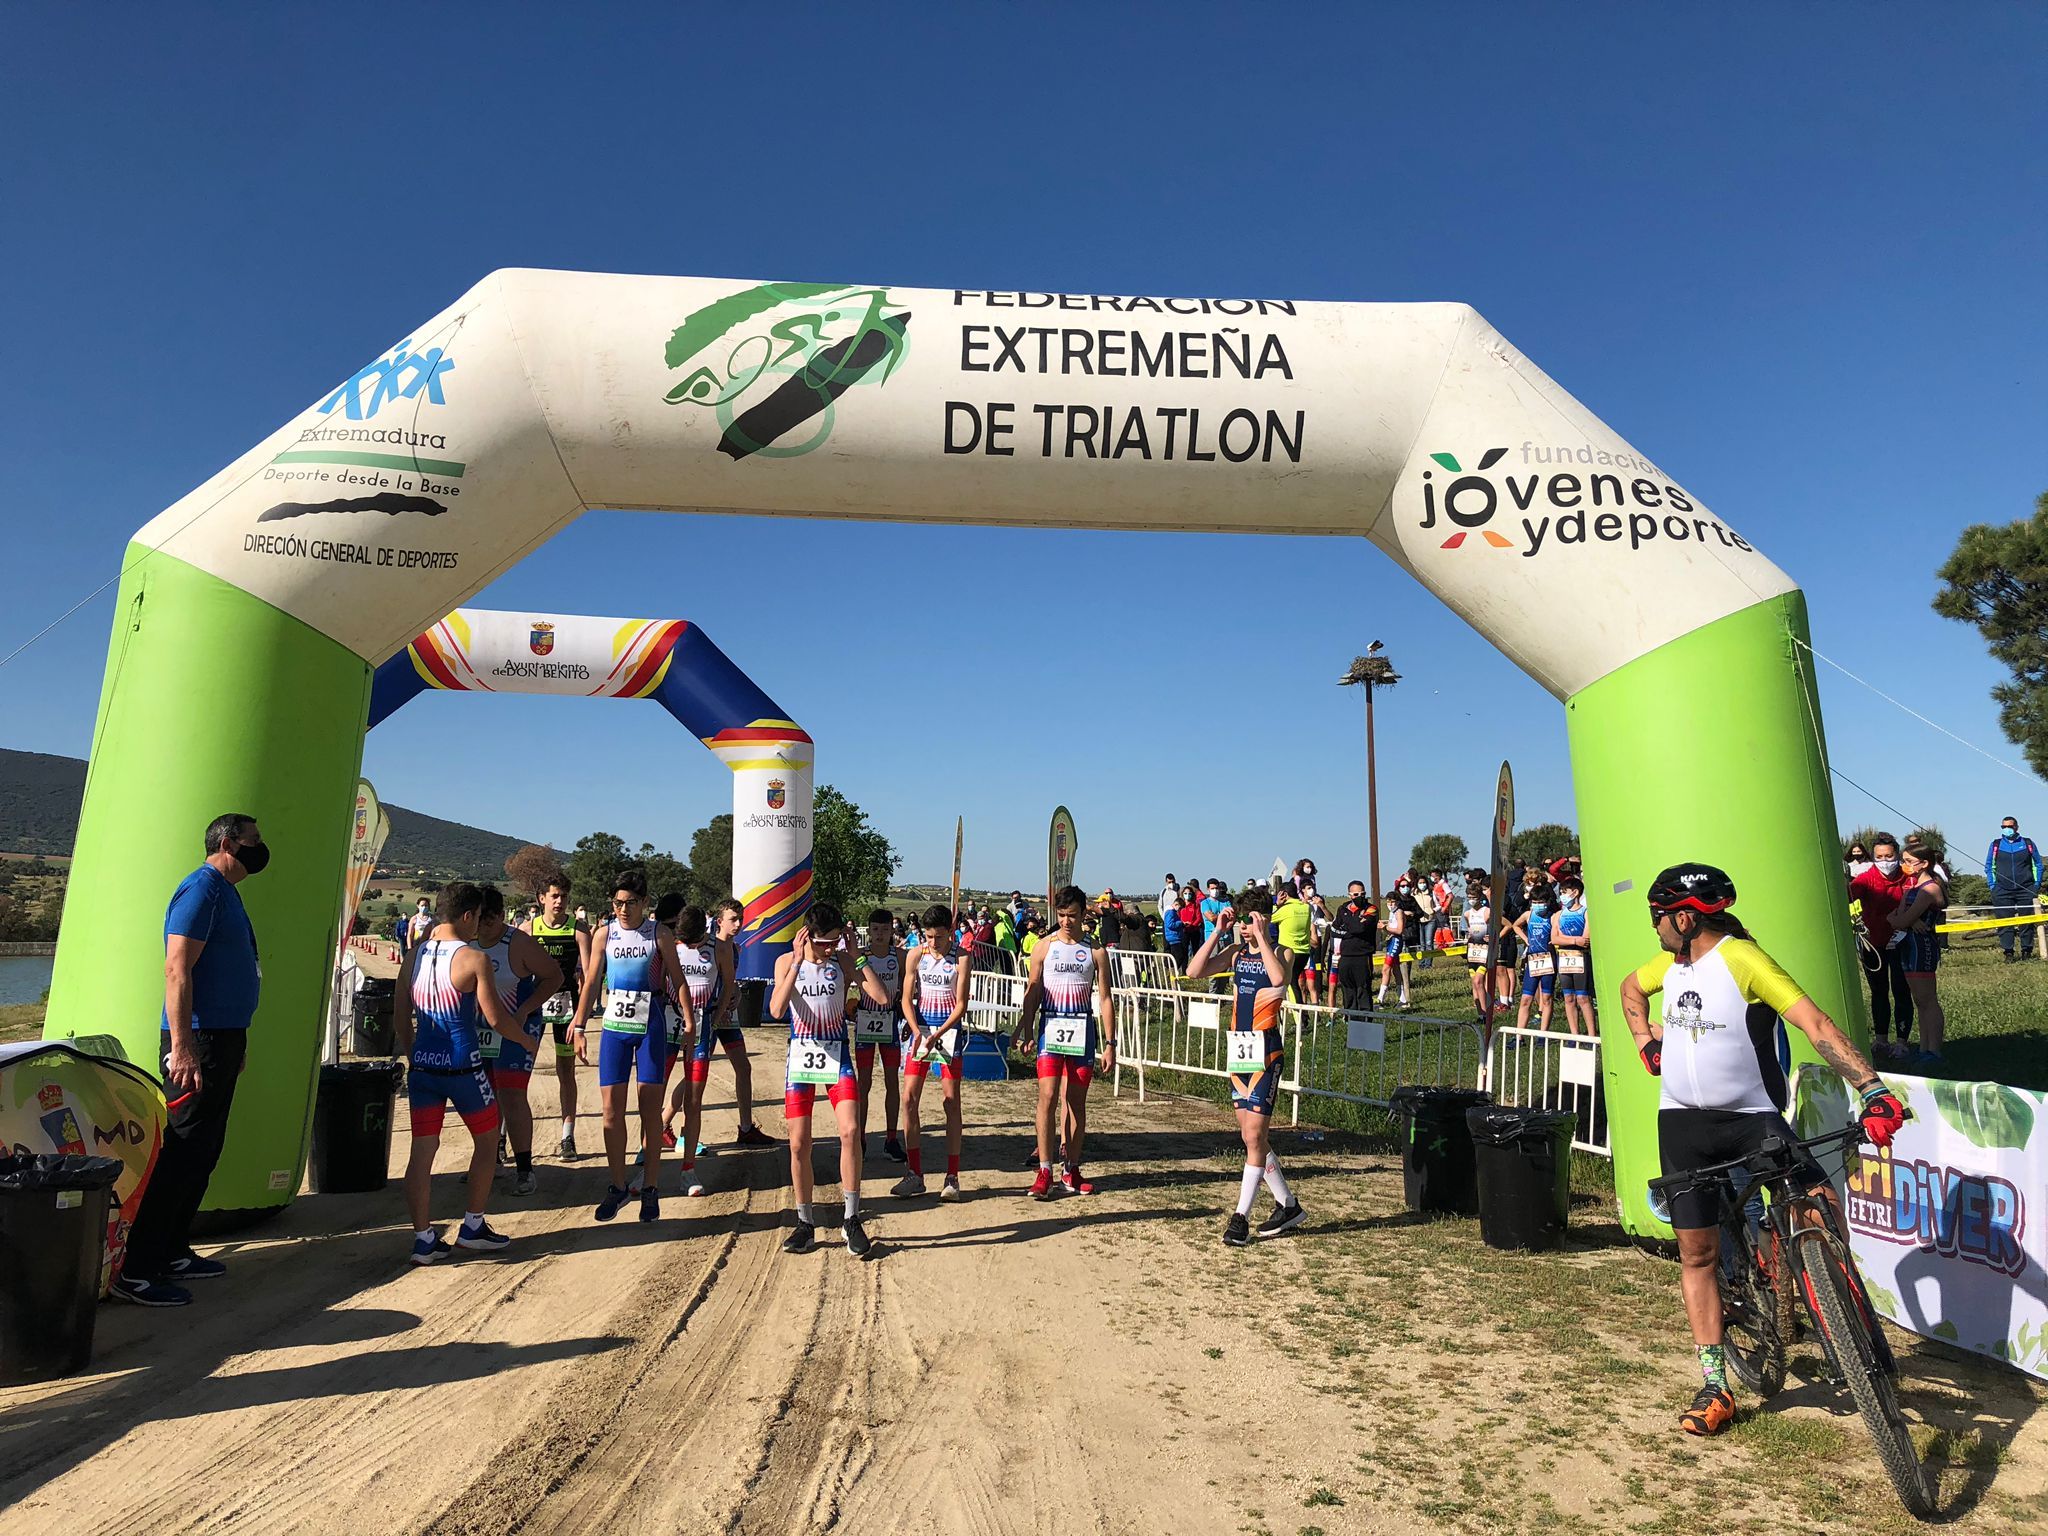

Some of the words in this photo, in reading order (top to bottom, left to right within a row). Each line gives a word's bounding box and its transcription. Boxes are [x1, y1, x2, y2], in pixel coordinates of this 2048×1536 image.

[961, 325, 1294, 379] EXTREMEÑA
[300, 427, 447, 450] Extremadura
[944, 401, 1015, 456] DE
[1033, 404, 1305, 462] TRIATLON
[264, 468, 330, 483] Deporte
[337, 470, 390, 488] desde
[397, 475, 413, 491] la
[421, 479, 461, 497] Base
[243, 534, 307, 557] DIRECIÓN
[311, 540, 372, 565] GENERAL
[377, 548, 393, 567] DE
[397, 550, 459, 569] DEPORTES
[504, 659, 587, 672] Ayuntamiento
[543, 669, 590, 680] BENITO
[750, 813, 806, 822] Ayuntamiento
[777, 820, 807, 829] BENITO
[613, 946, 648, 959] GARCIA
[1054, 963, 1084, 973] ALEJANDRO
[1236, 960, 1267, 975] HERRERA
[1534, 960, 1545, 968] 77
[1566, 958, 1576, 966] 73
[681, 965, 707, 975] RENAS
[922, 974, 942, 984] DIEGO
[800, 981, 835, 997] ALÍAS
[615, 1002, 635, 1018] 35
[867, 1020, 884, 1033] 42
[1056, 1029, 1075, 1043] 37
[414, 1049, 452, 1067] GARCÍA
[1237, 1044, 1254, 1060] 31
[803, 1052, 826, 1069] 33
[1851, 1196, 1892, 1228] FETRI
